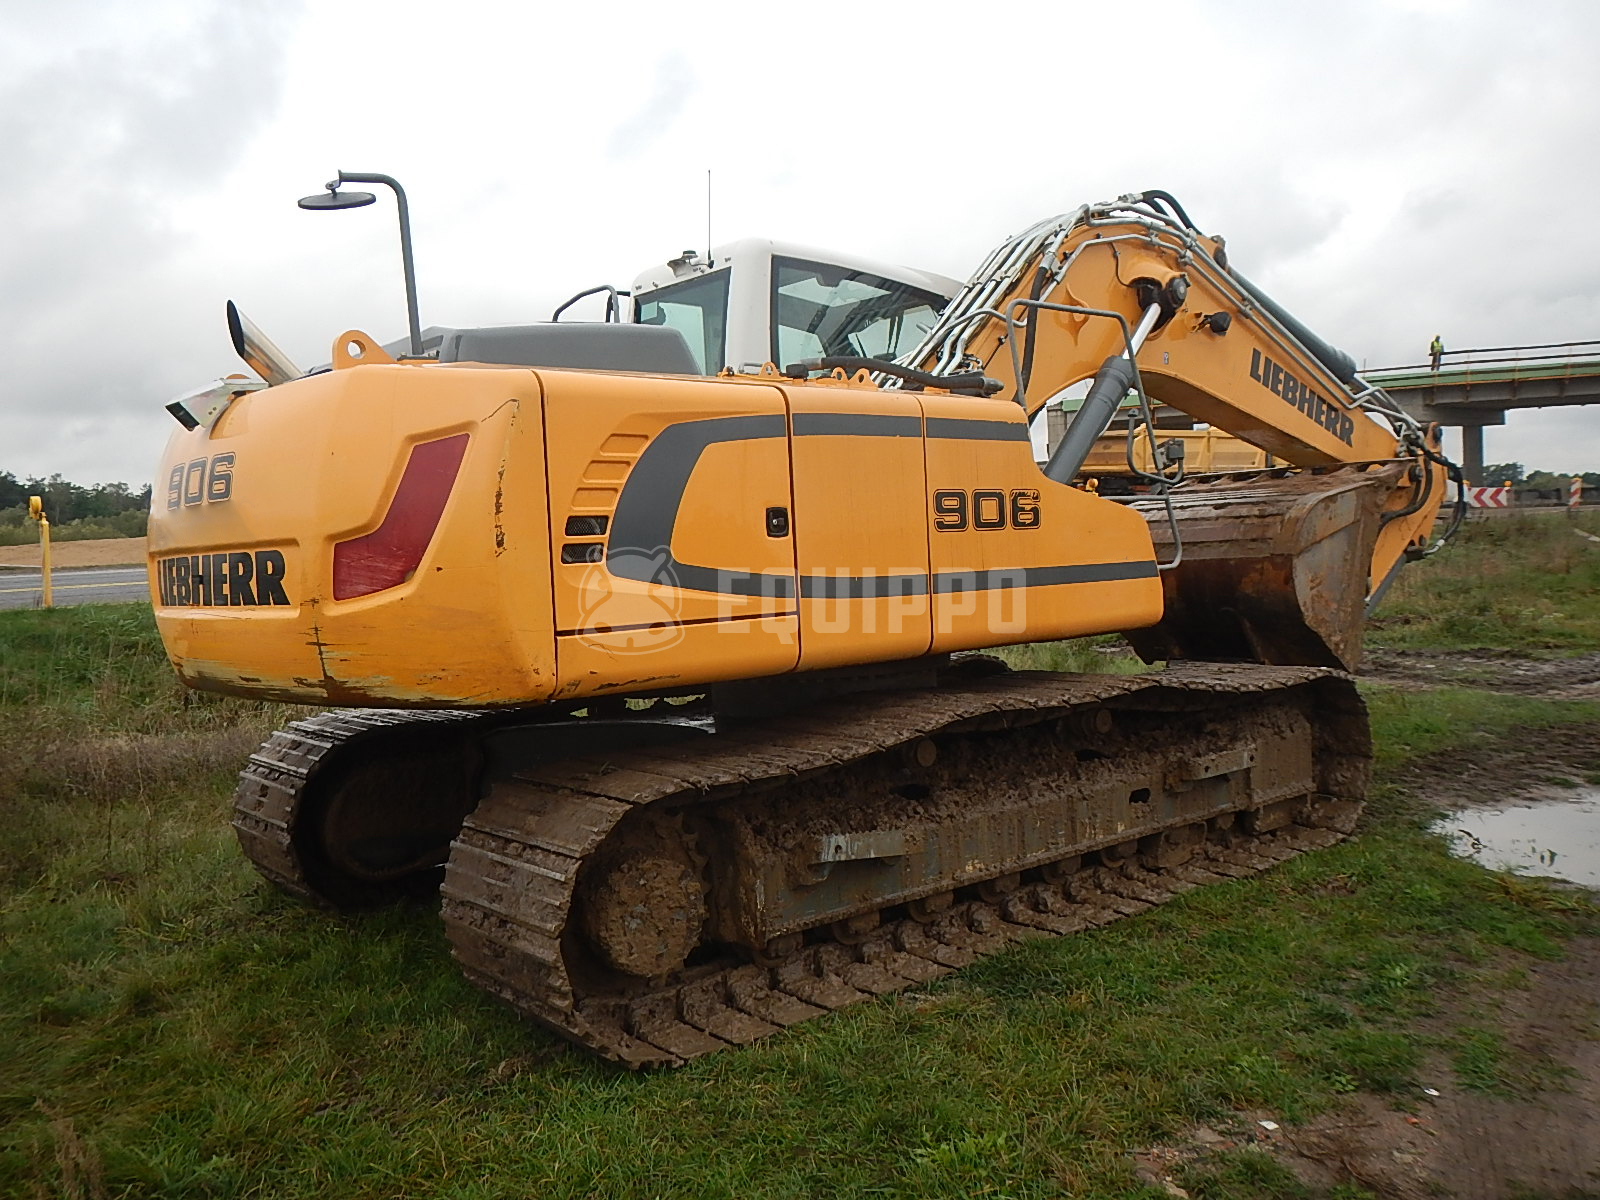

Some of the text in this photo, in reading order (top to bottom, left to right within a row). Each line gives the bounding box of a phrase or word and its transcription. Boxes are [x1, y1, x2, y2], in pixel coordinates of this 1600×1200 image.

[1250, 348, 1354, 447] LIEBHERR
[167, 452, 236, 511] 906
[933, 488, 1041, 532] 906
[157, 550, 291, 606] LIEBHERR
